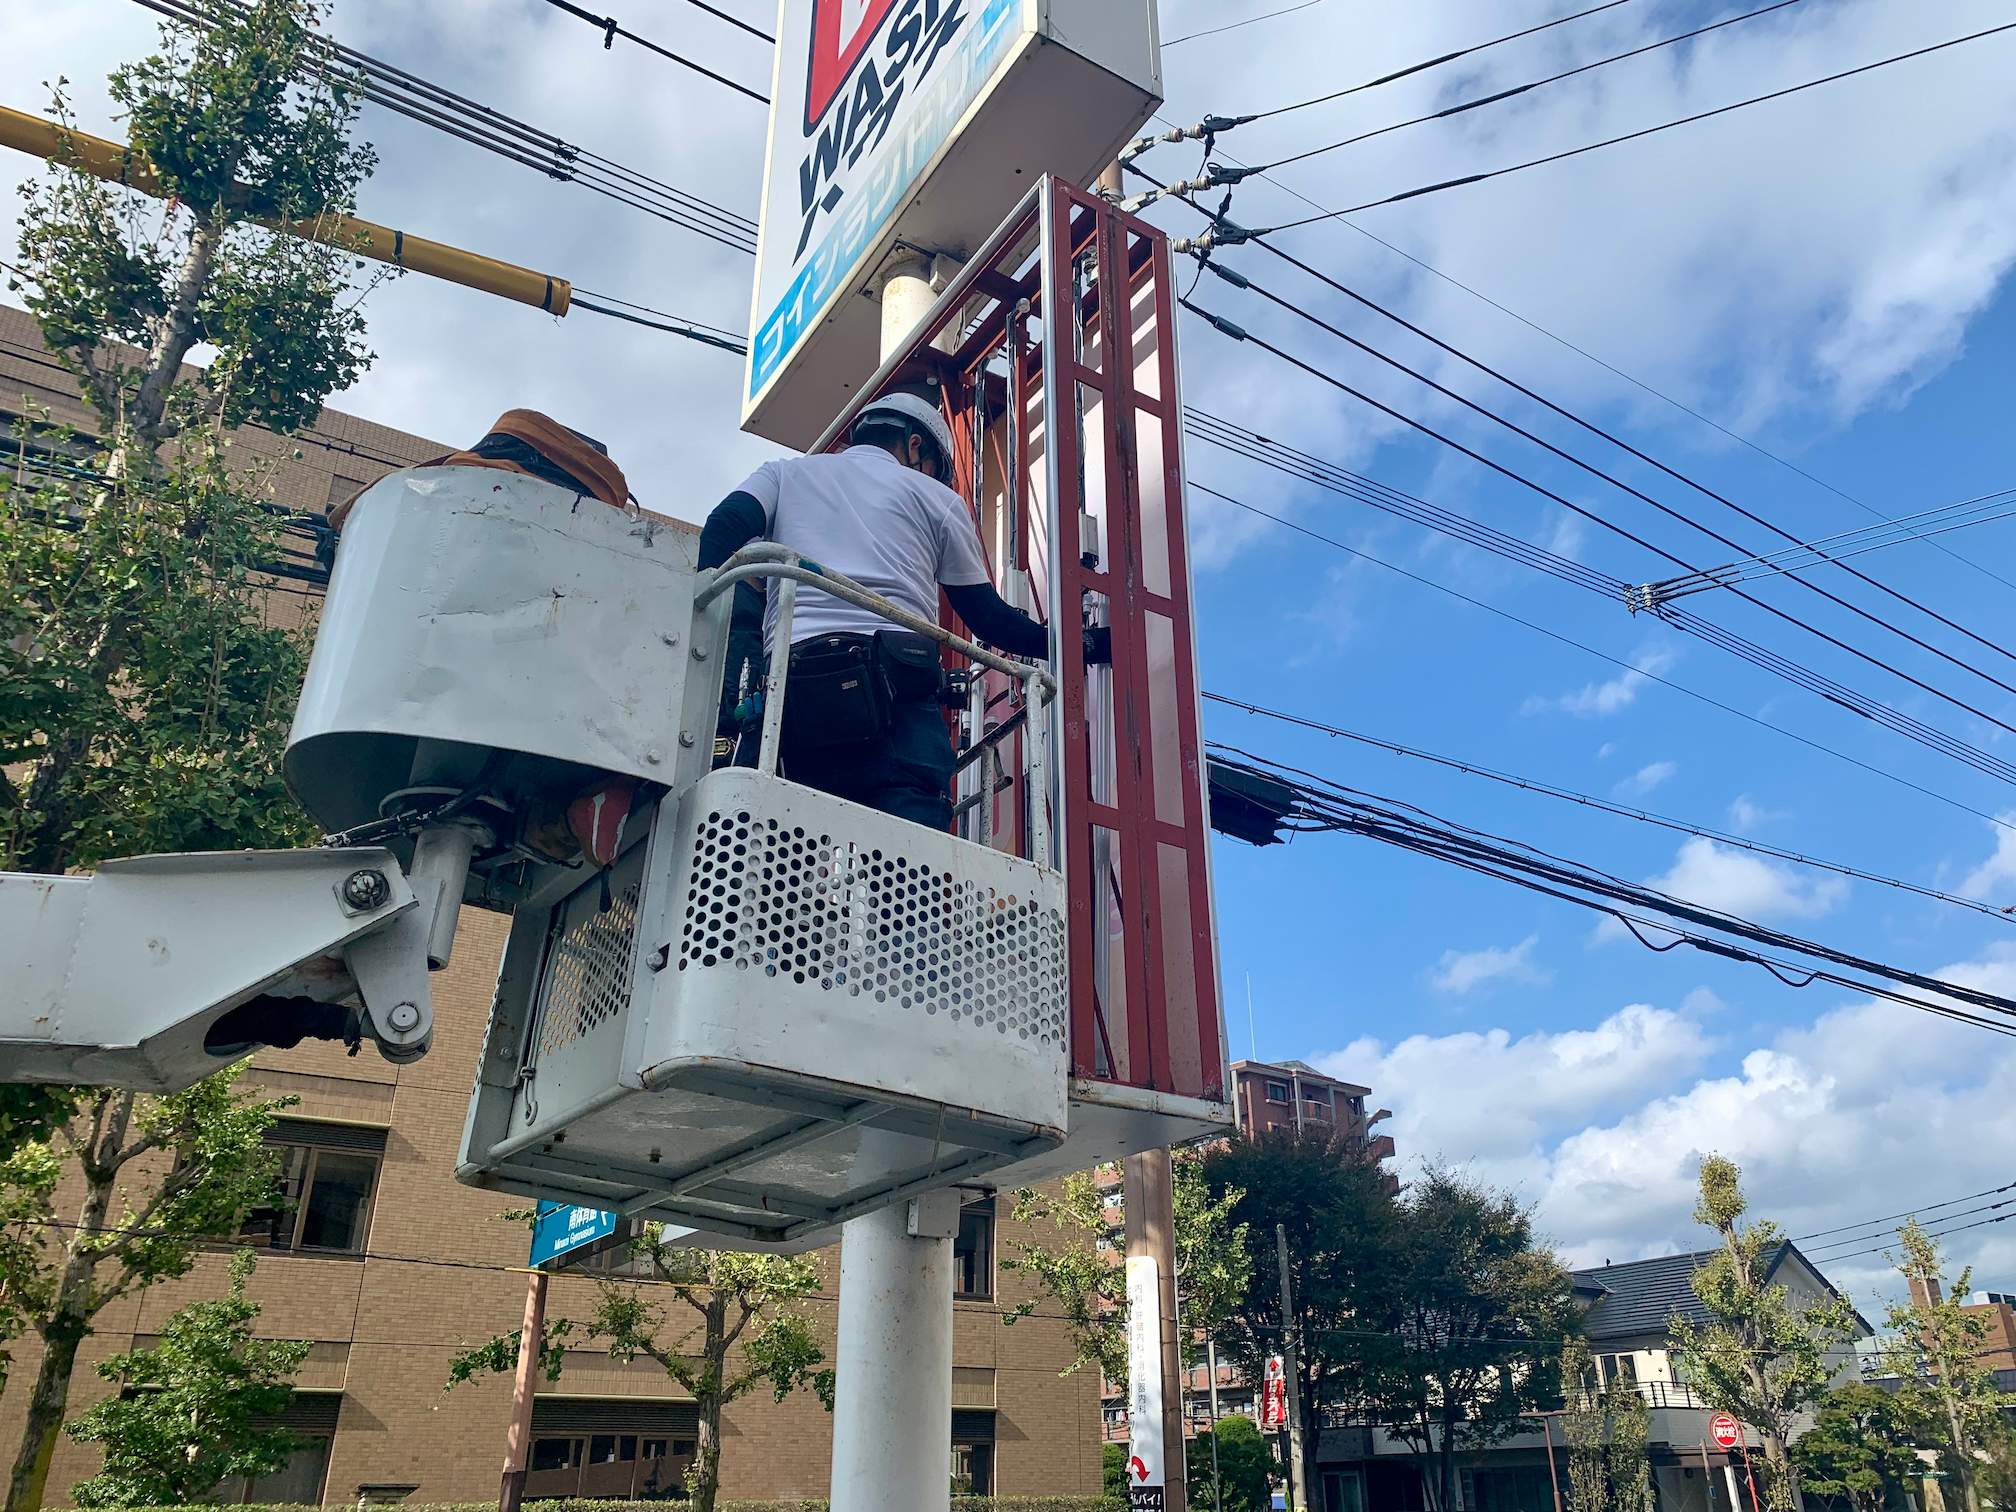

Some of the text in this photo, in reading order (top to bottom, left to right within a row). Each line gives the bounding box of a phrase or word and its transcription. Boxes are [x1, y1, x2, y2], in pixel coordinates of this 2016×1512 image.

[756, 2, 1011, 375] コインランドリー
[1715, 1426, 1737, 1438] 消火栓
